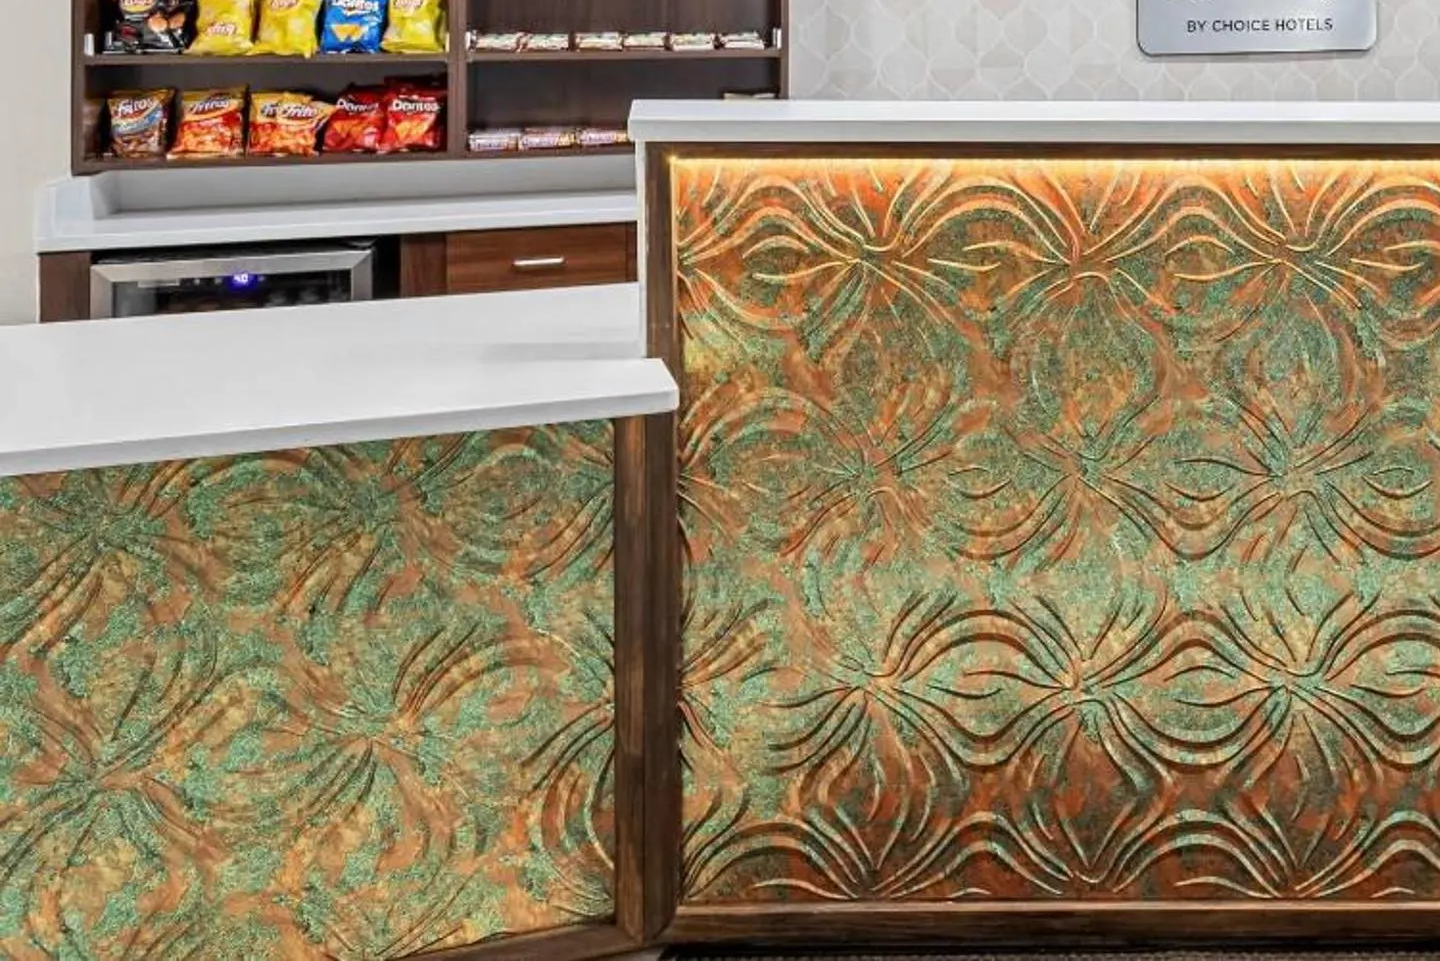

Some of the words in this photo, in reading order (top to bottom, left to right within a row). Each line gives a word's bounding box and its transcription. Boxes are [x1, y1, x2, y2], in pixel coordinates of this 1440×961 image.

[1187, 19, 1207, 33] BY
[1212, 19, 1270, 32] CHOICE
[1275, 18, 1334, 32] HOTELS
